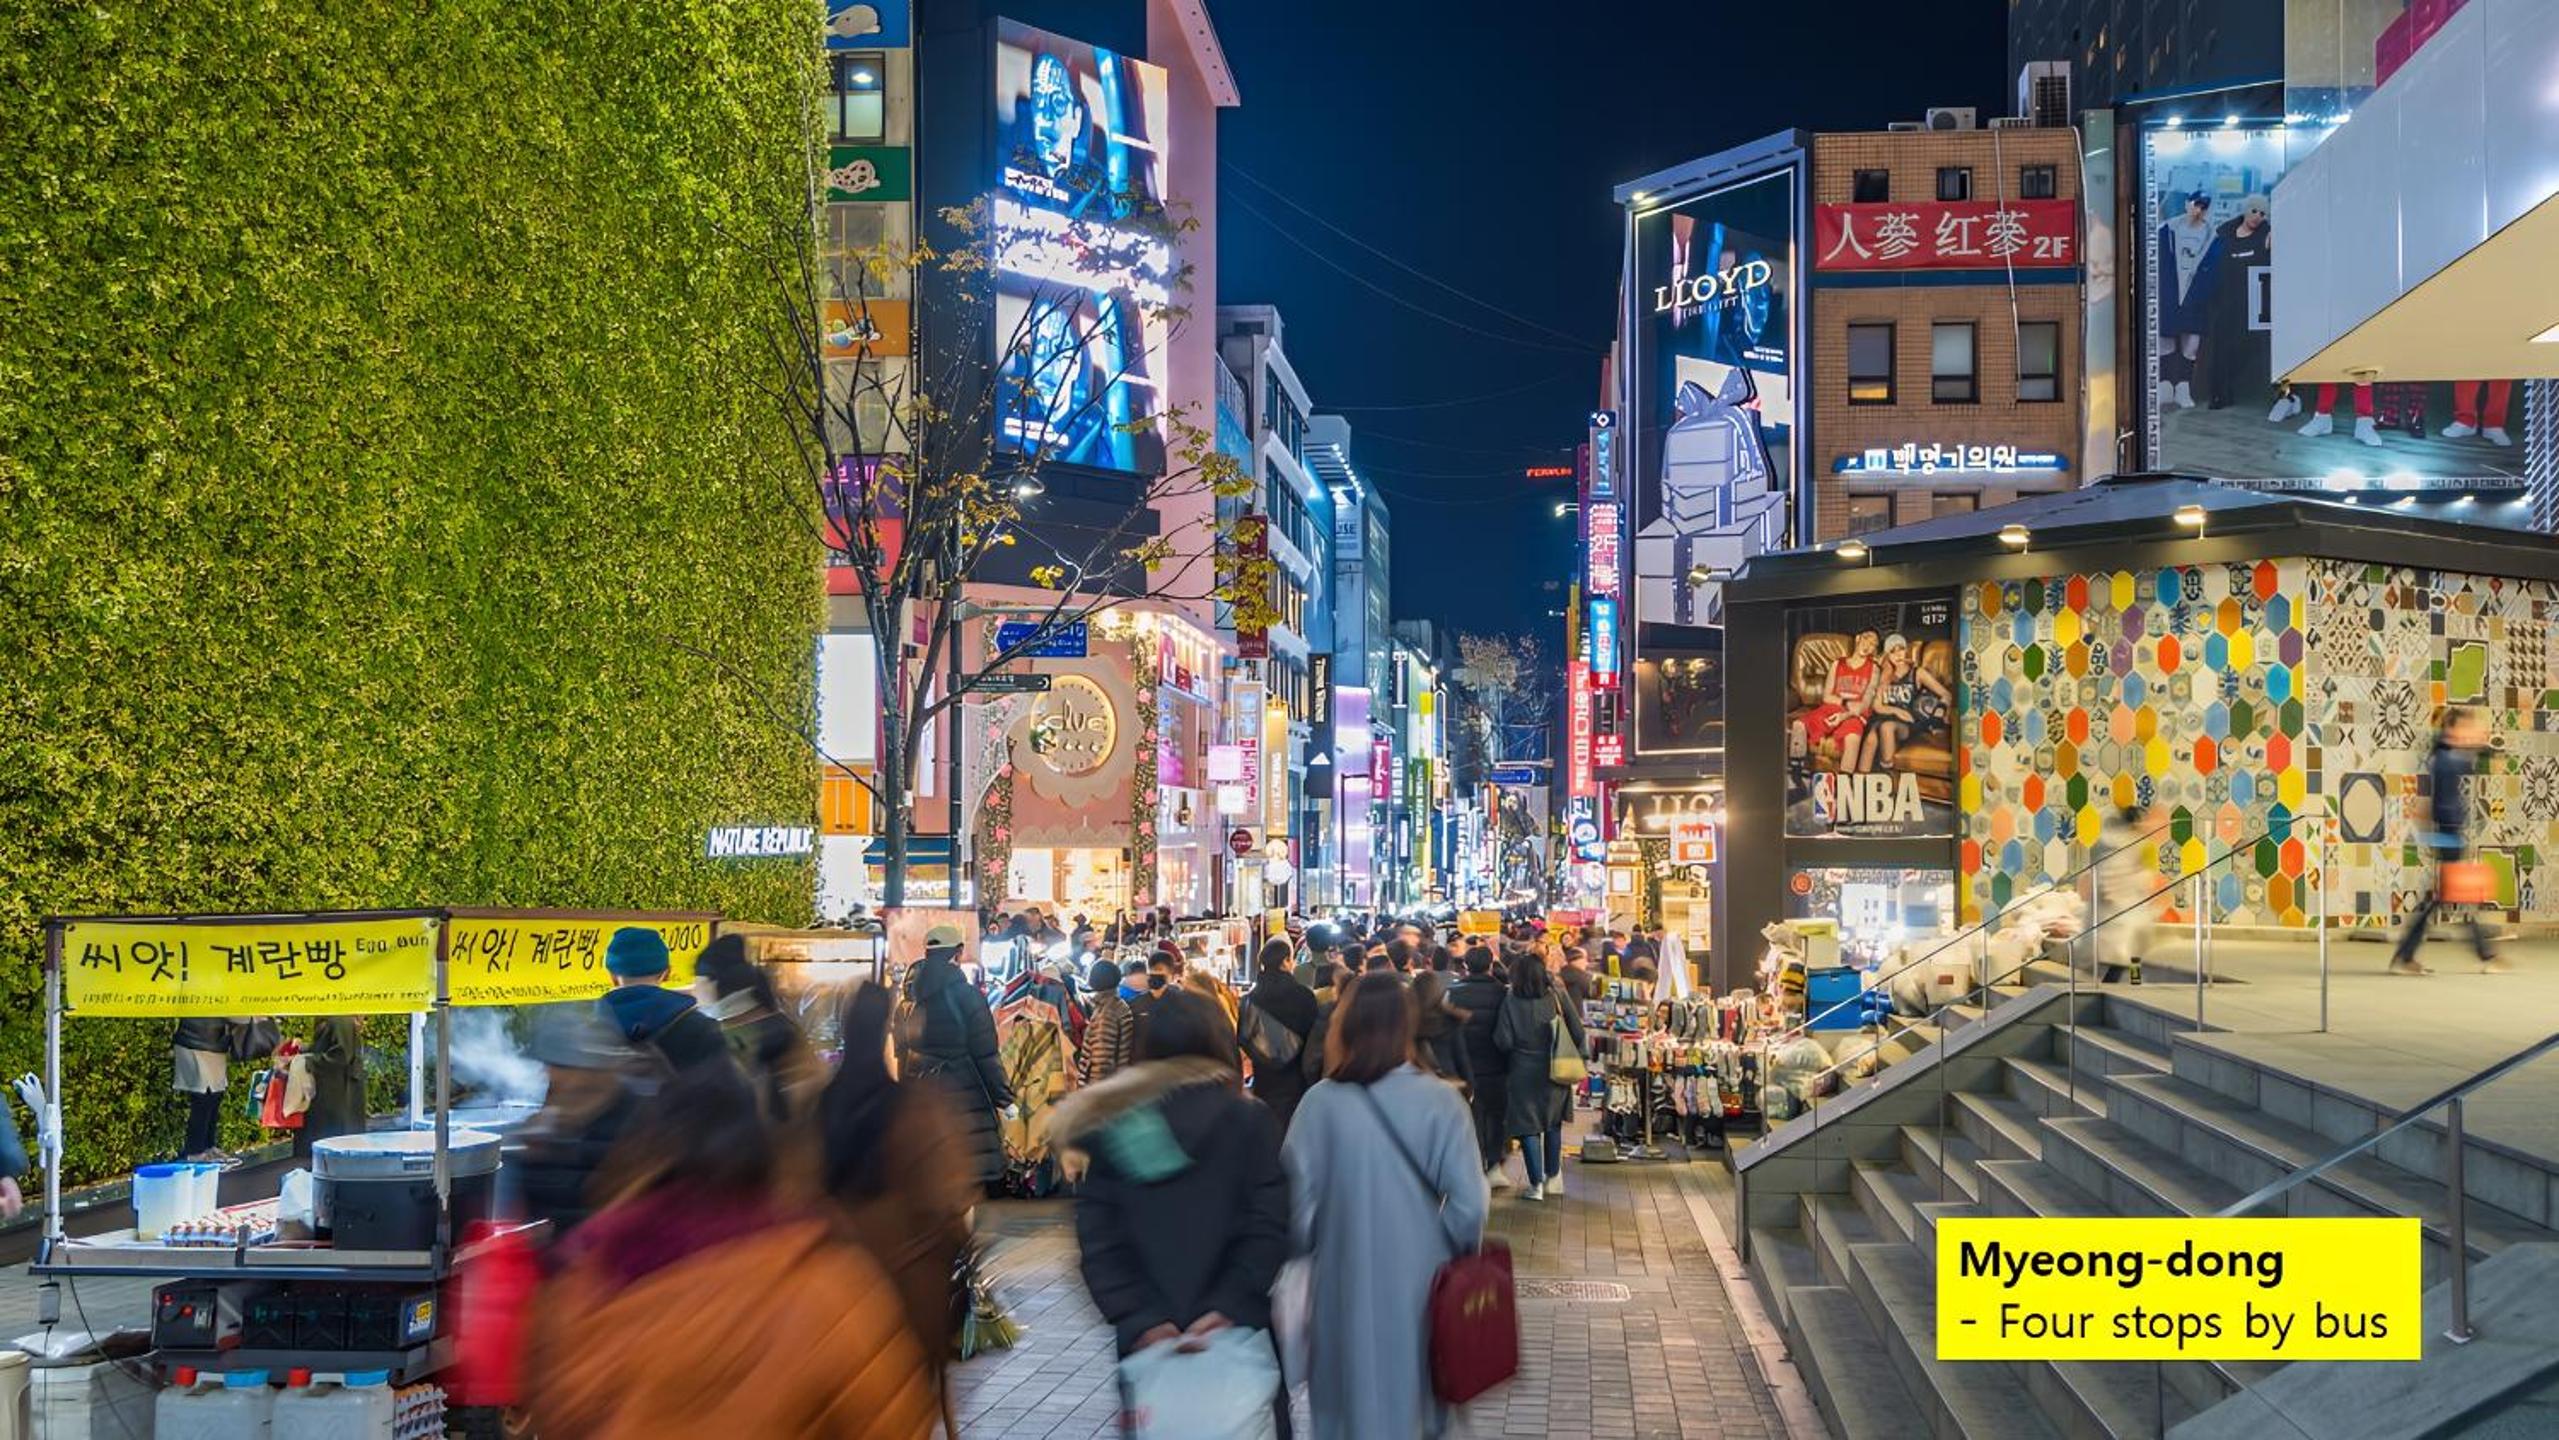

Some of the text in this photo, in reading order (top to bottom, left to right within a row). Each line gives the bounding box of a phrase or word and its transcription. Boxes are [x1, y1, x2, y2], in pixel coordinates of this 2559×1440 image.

[2033, 236, 2071, 259] 2F
[1653, 260, 1771, 312] LLOYD
[1837, 772, 1925, 823] NBA
[708, 827, 761, 856] NATURE
[210, 939, 346, 981] 계란빵
[529, 928, 601, 971] 계란빵
